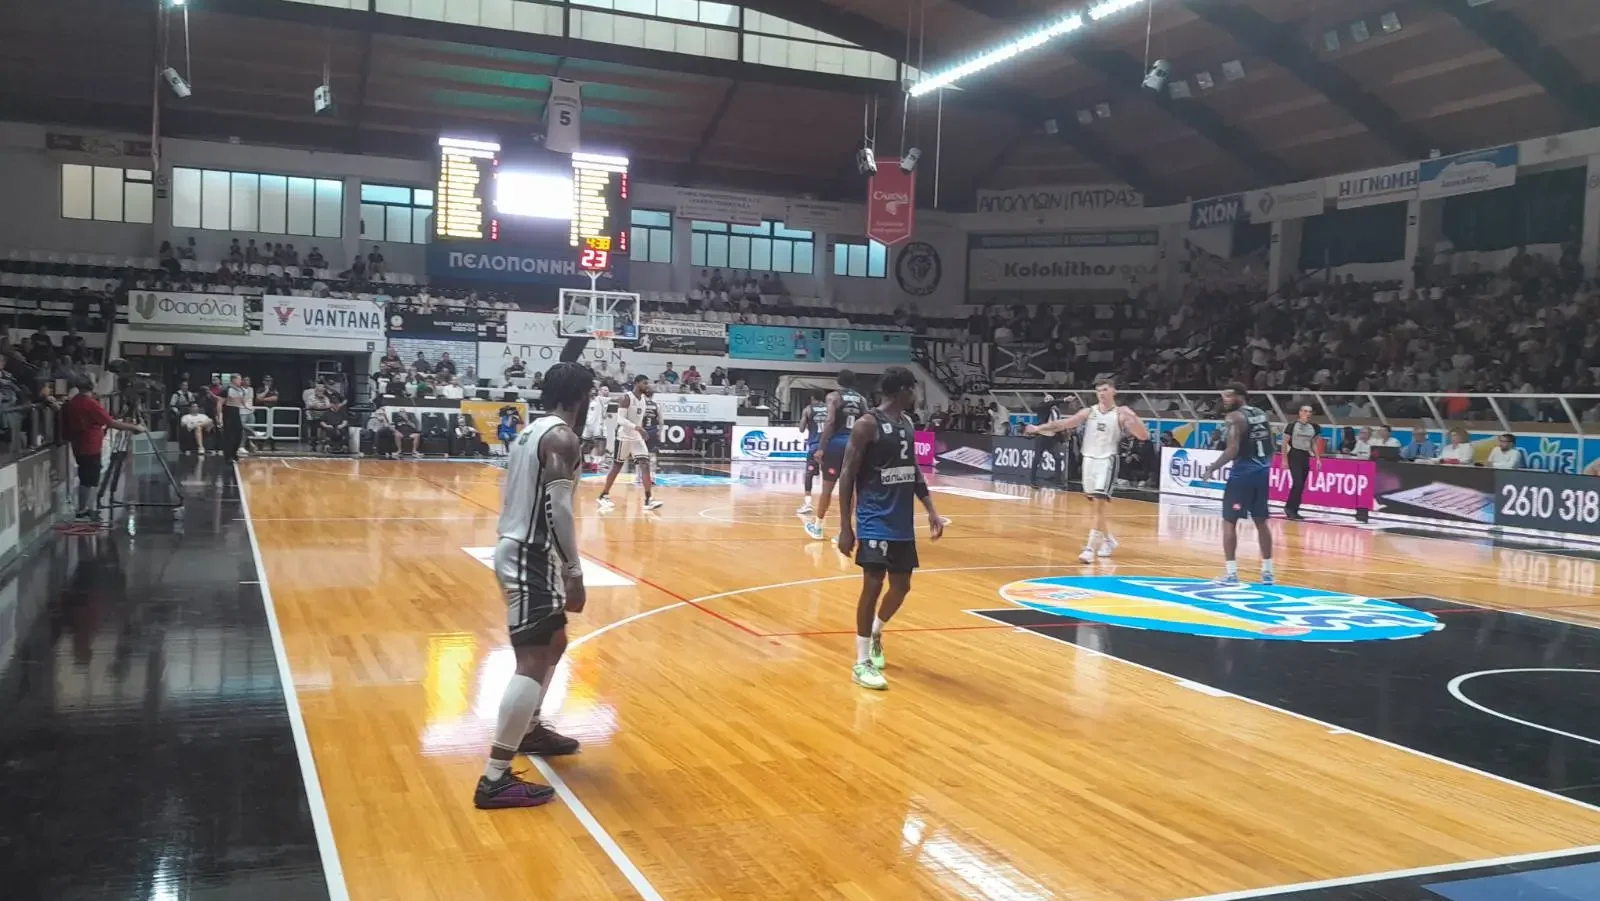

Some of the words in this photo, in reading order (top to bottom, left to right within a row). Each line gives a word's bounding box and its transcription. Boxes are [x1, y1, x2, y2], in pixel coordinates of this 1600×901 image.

[559, 110, 572, 126] 5
[449, 252, 576, 276] ΠΕΛΟΠΟΝΝΗ
[581, 250, 607, 268] 23
[303, 308, 380, 329] VANTANA
[744, 436, 807, 452] Soluti
[900, 440, 908, 459] 2
[913, 441, 931, 456] TOP
[994, 447, 1020, 467] 2610
[1308, 471, 1368, 496] LAPTOP
[1501, 484, 1554, 518] 2610
[1559, 488, 1600, 524] 318
